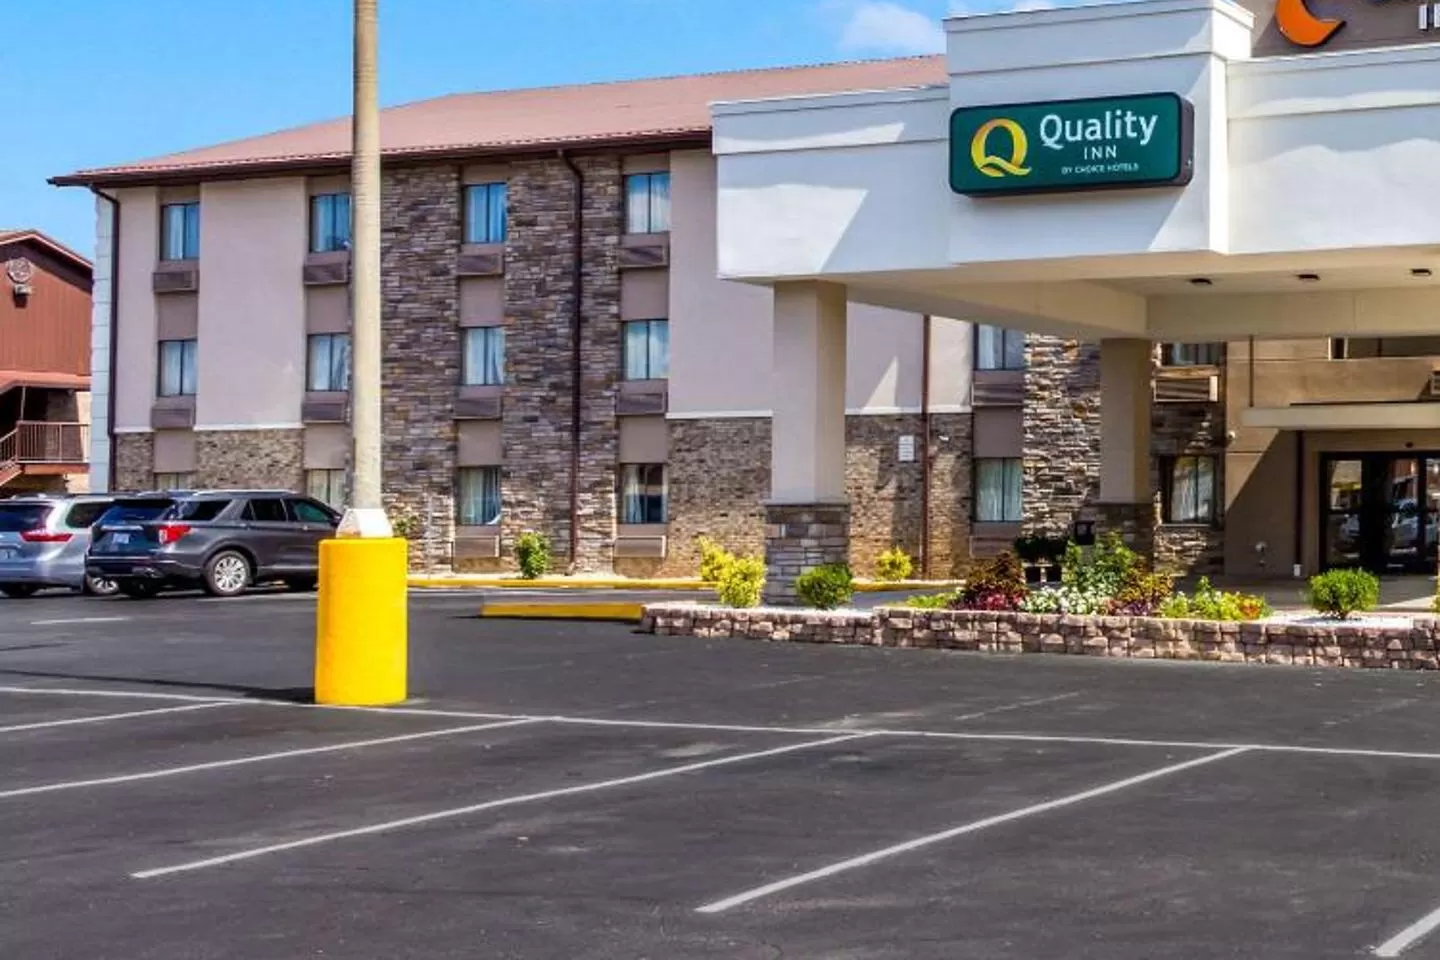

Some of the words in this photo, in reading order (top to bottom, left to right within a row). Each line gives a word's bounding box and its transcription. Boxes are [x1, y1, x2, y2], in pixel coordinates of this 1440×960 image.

[971, 118, 1032, 177] Q
[1039, 109, 1158, 150] Quality
[1084, 145, 1117, 160] INN
